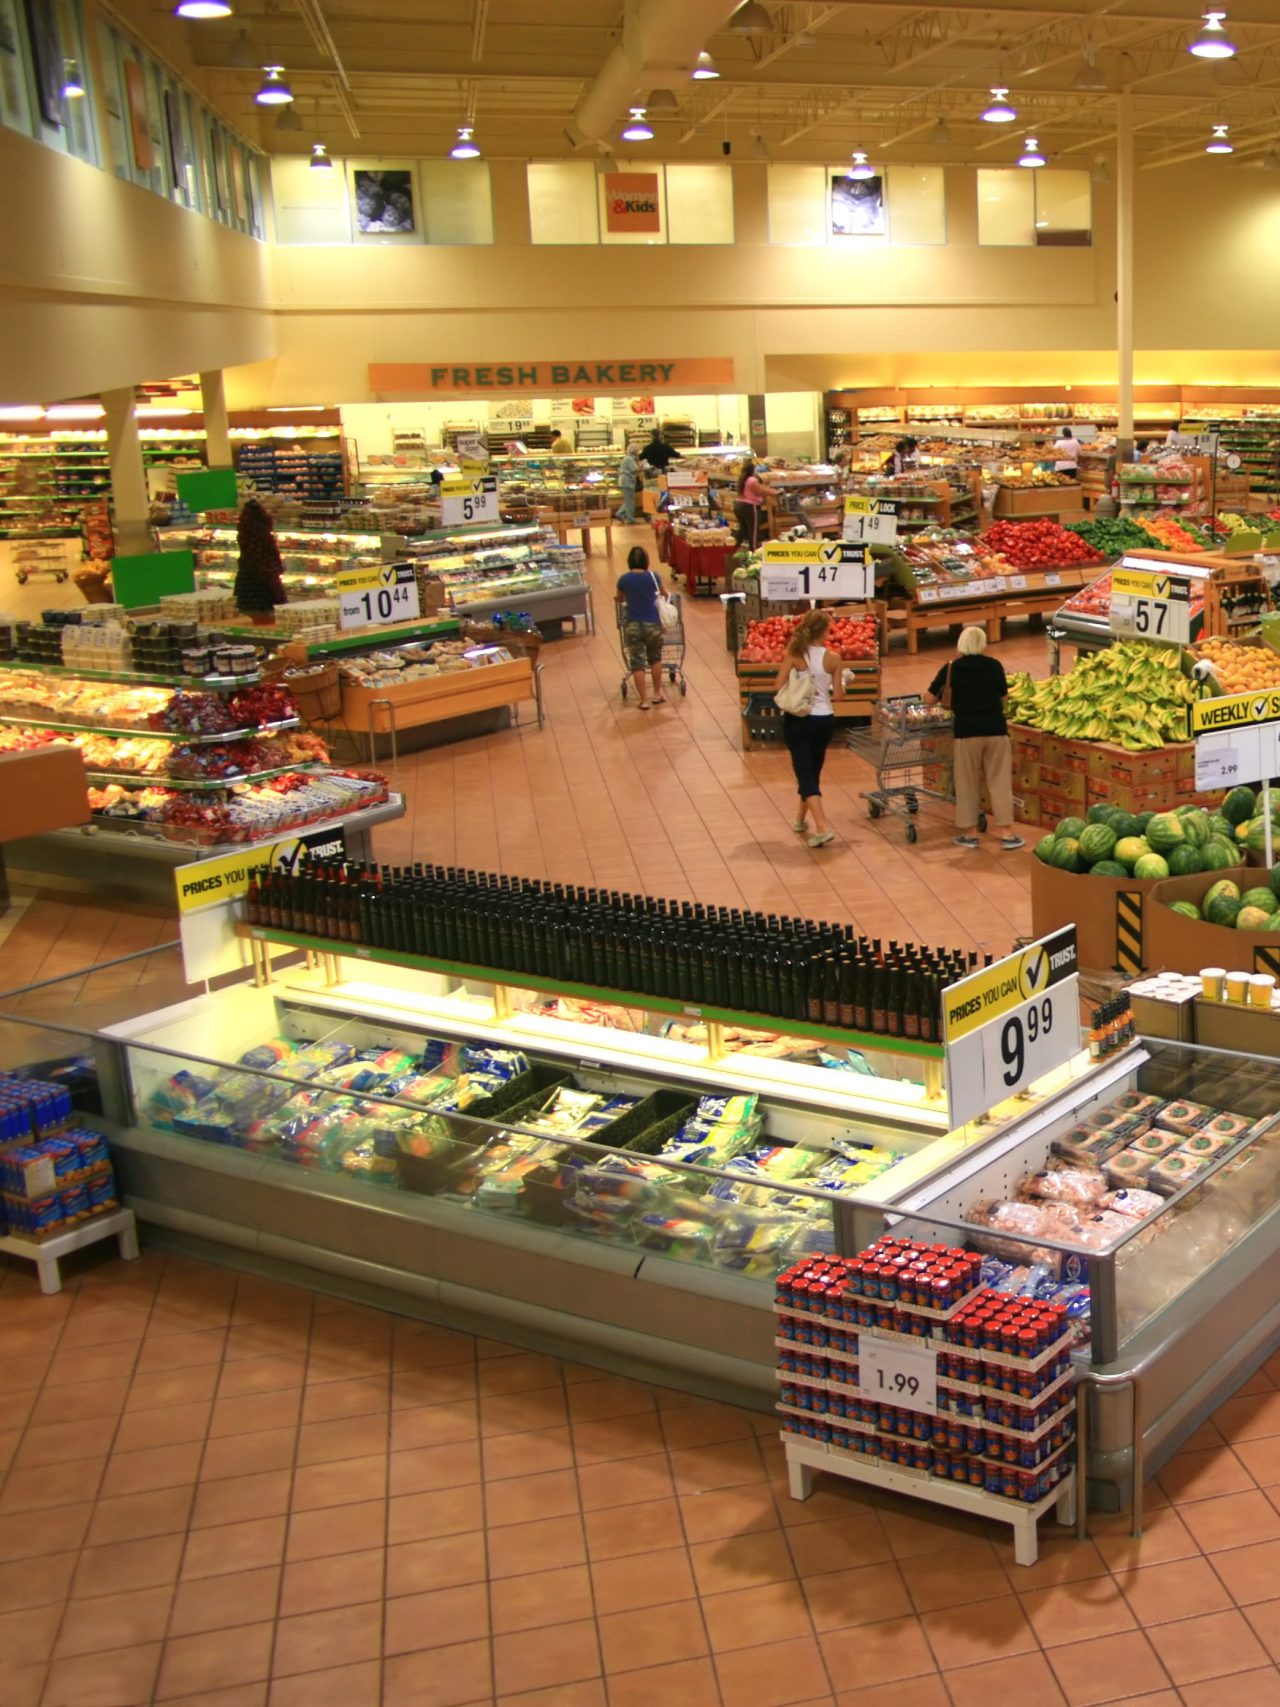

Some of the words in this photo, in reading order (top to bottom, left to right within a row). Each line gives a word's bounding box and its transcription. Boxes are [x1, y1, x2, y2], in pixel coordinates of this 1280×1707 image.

[430, 366, 538, 387] FRESH
[551, 363, 675, 385] BAKERY
[463, 497, 474, 520] 5
[343, 606, 360, 617] from
[361, 589, 392, 621] 10
[1135, 599, 1168, 635] 57
[1200, 701, 1250, 726] WEEKLY
[1221, 765, 1238, 775] 2.99
[182, 875, 223, 897] PRICES
[224, 870, 246, 886] YOU
[949, 996, 982, 1026] PRICES
[982, 990, 1000, 1007] YOU
[1000, 976, 1018, 997] CAN
[876, 1368, 920, 1396] 1.99
